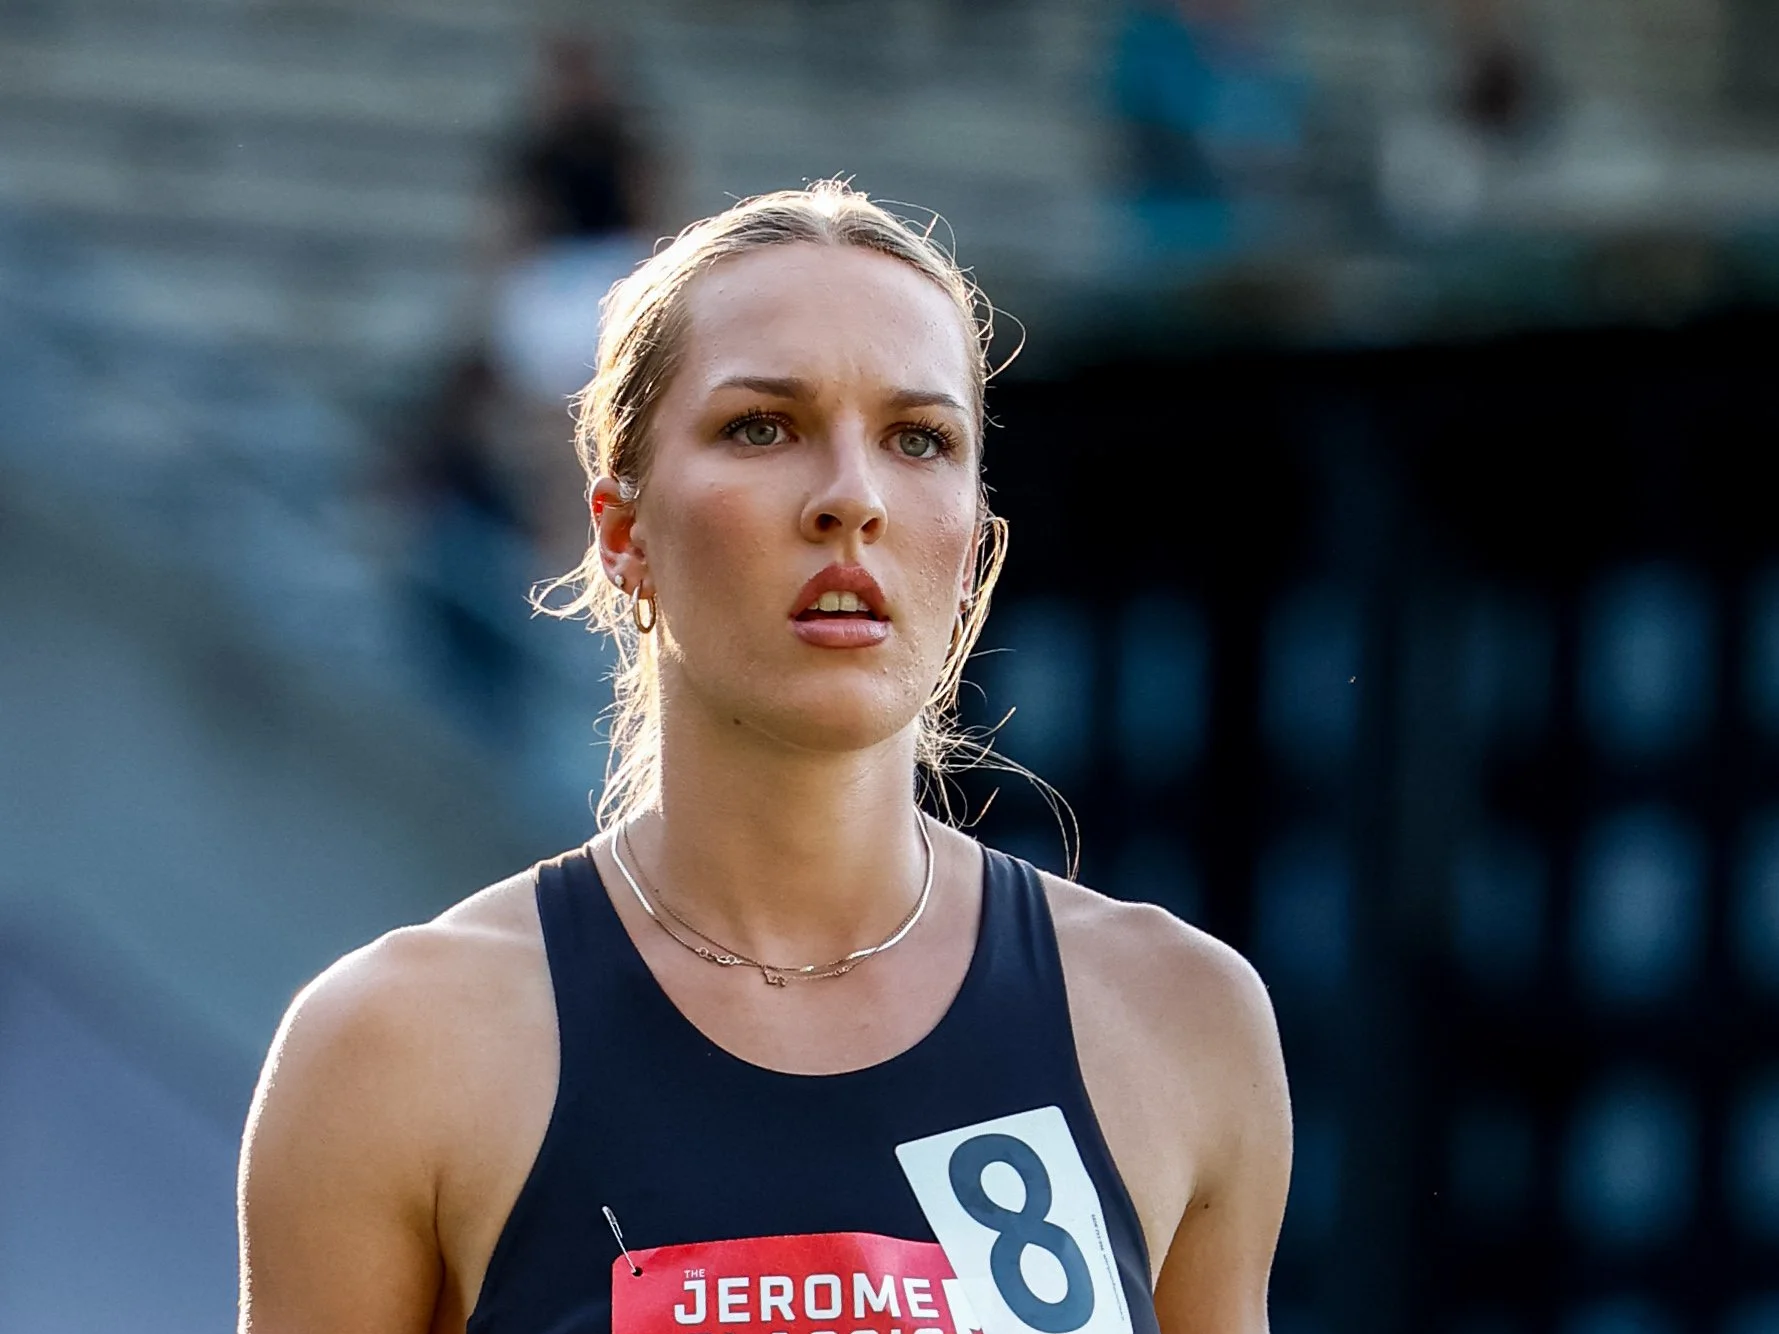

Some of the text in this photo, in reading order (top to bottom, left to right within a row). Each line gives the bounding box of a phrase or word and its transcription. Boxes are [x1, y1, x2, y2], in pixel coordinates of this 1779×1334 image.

[948, 1133, 1096, 1334] 8
[674, 1273, 941, 1326] JEROME
[683, 1268, 706, 1279] THE
